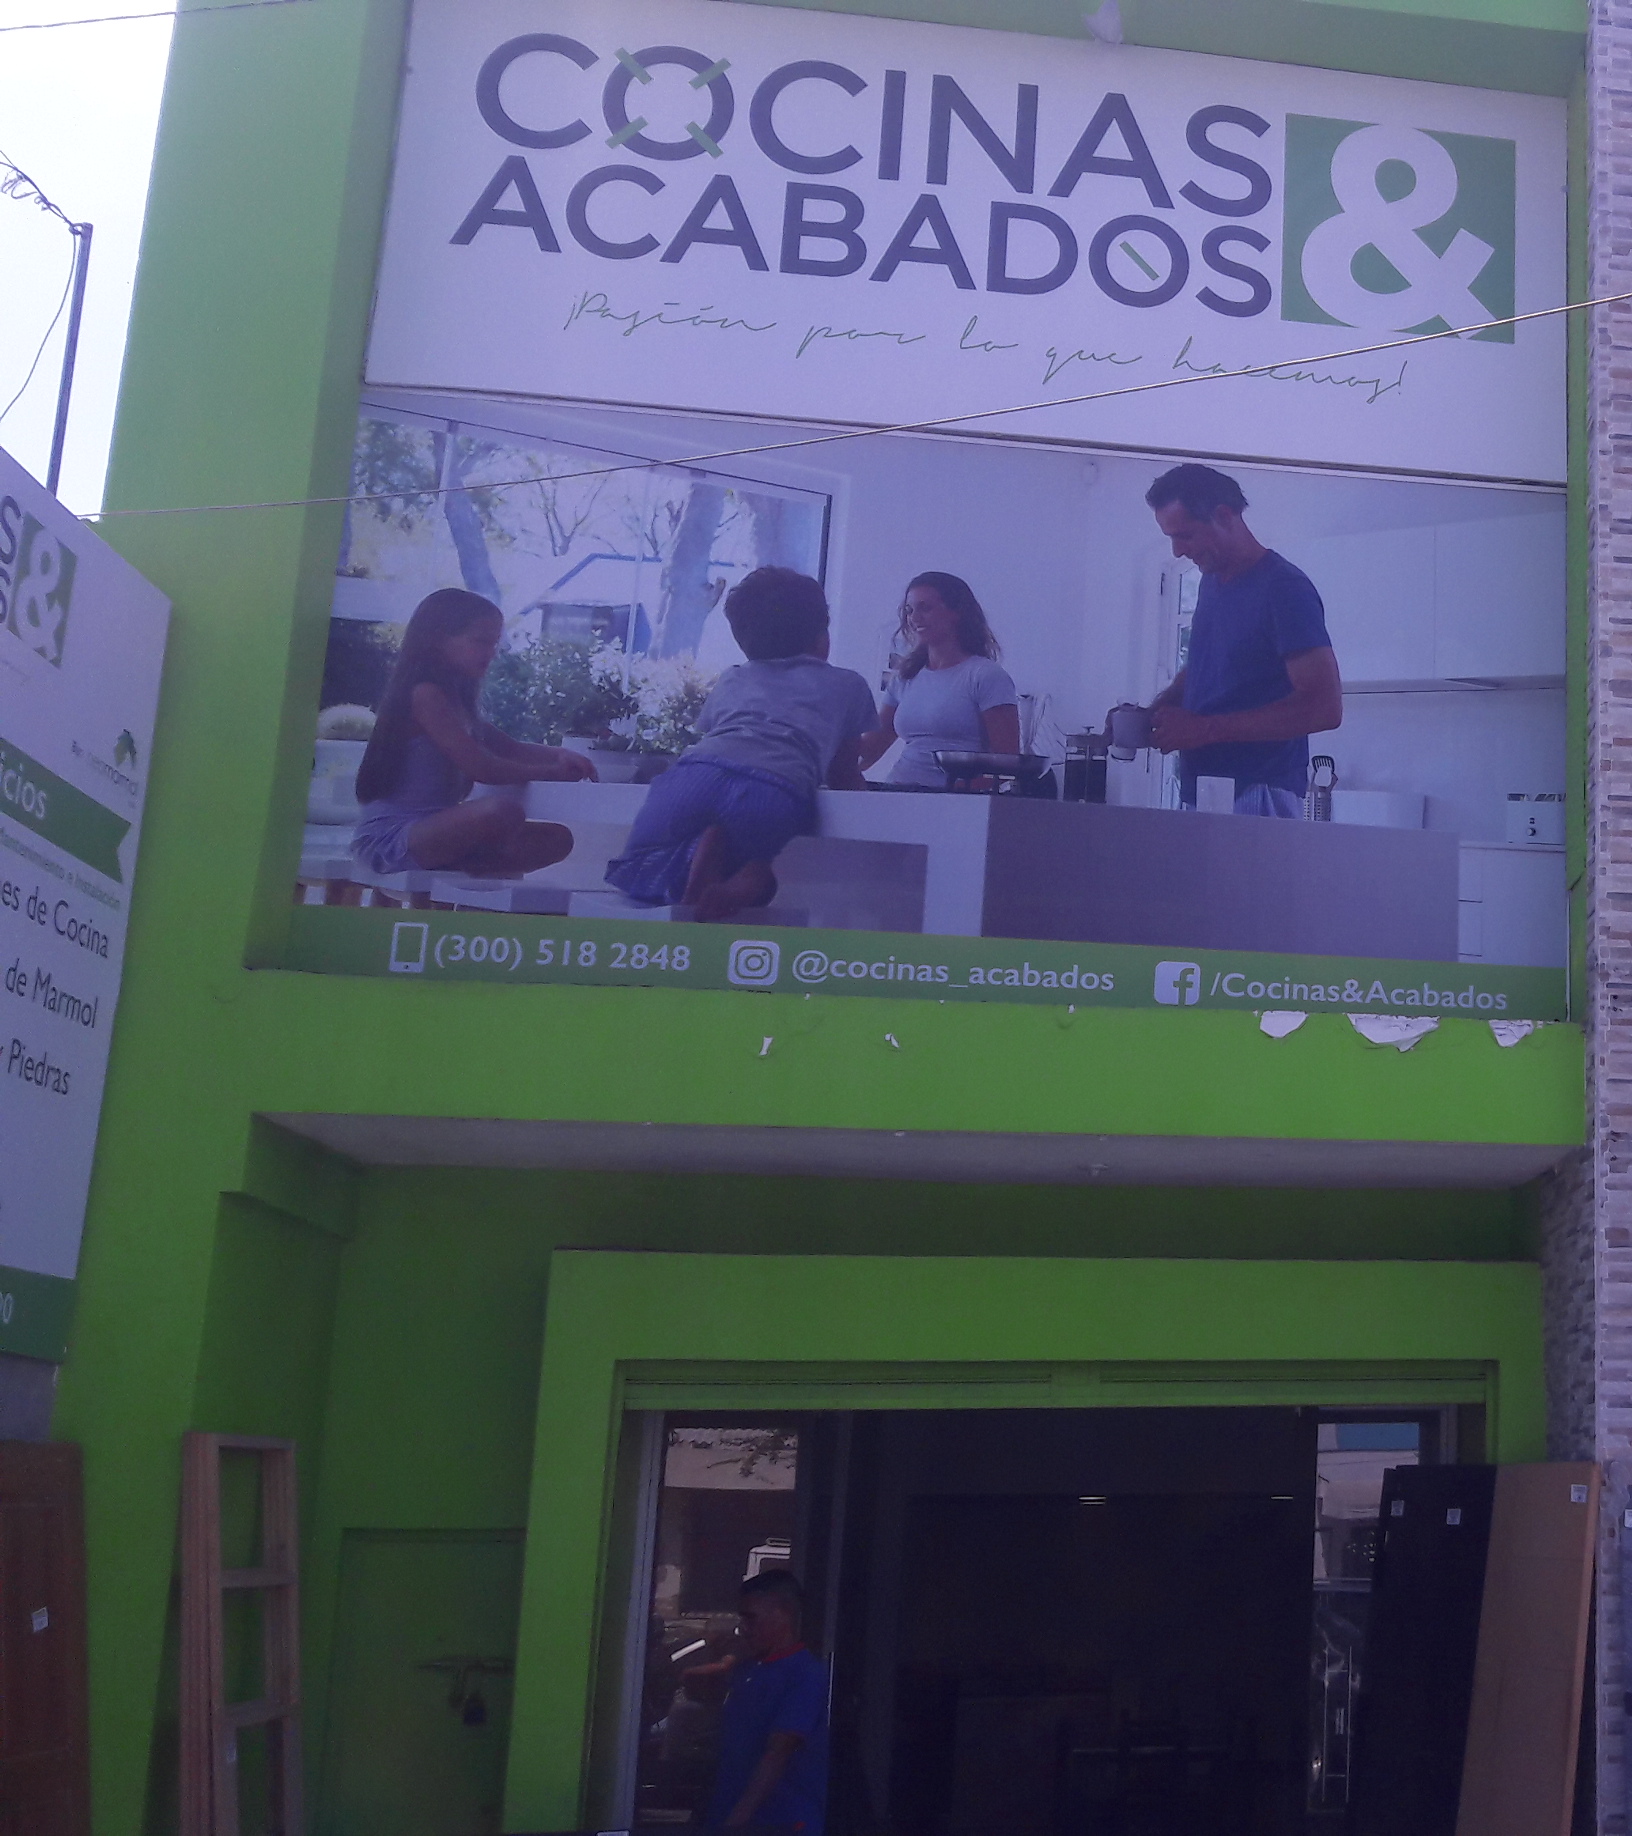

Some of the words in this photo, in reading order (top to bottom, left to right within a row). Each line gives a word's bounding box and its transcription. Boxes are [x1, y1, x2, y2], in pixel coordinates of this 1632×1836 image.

[475, 33, 1273, 217] COCINAS
[449, 155, 1272, 318] ACABADOS
[795, 323, 927, 359] por
[959, 315, 1019, 351] lo
[1042, 345, 1143, 384] que
[27, 886, 47, 926] de
[54, 900, 109, 960] Cocina
[5, 958, 27, 997] de
[33, 966, 99, 1029] Marmol
[434, 935, 523, 972] (300)
[535, 936, 598, 968] 518
[609, 941, 691, 973] 2848
[791, 948, 1115, 992] @cocinas_acabados
[1209, 970, 1509, 1012] /Cocinas&Acabados
[7, 1037, 71, 1096] Piedras
